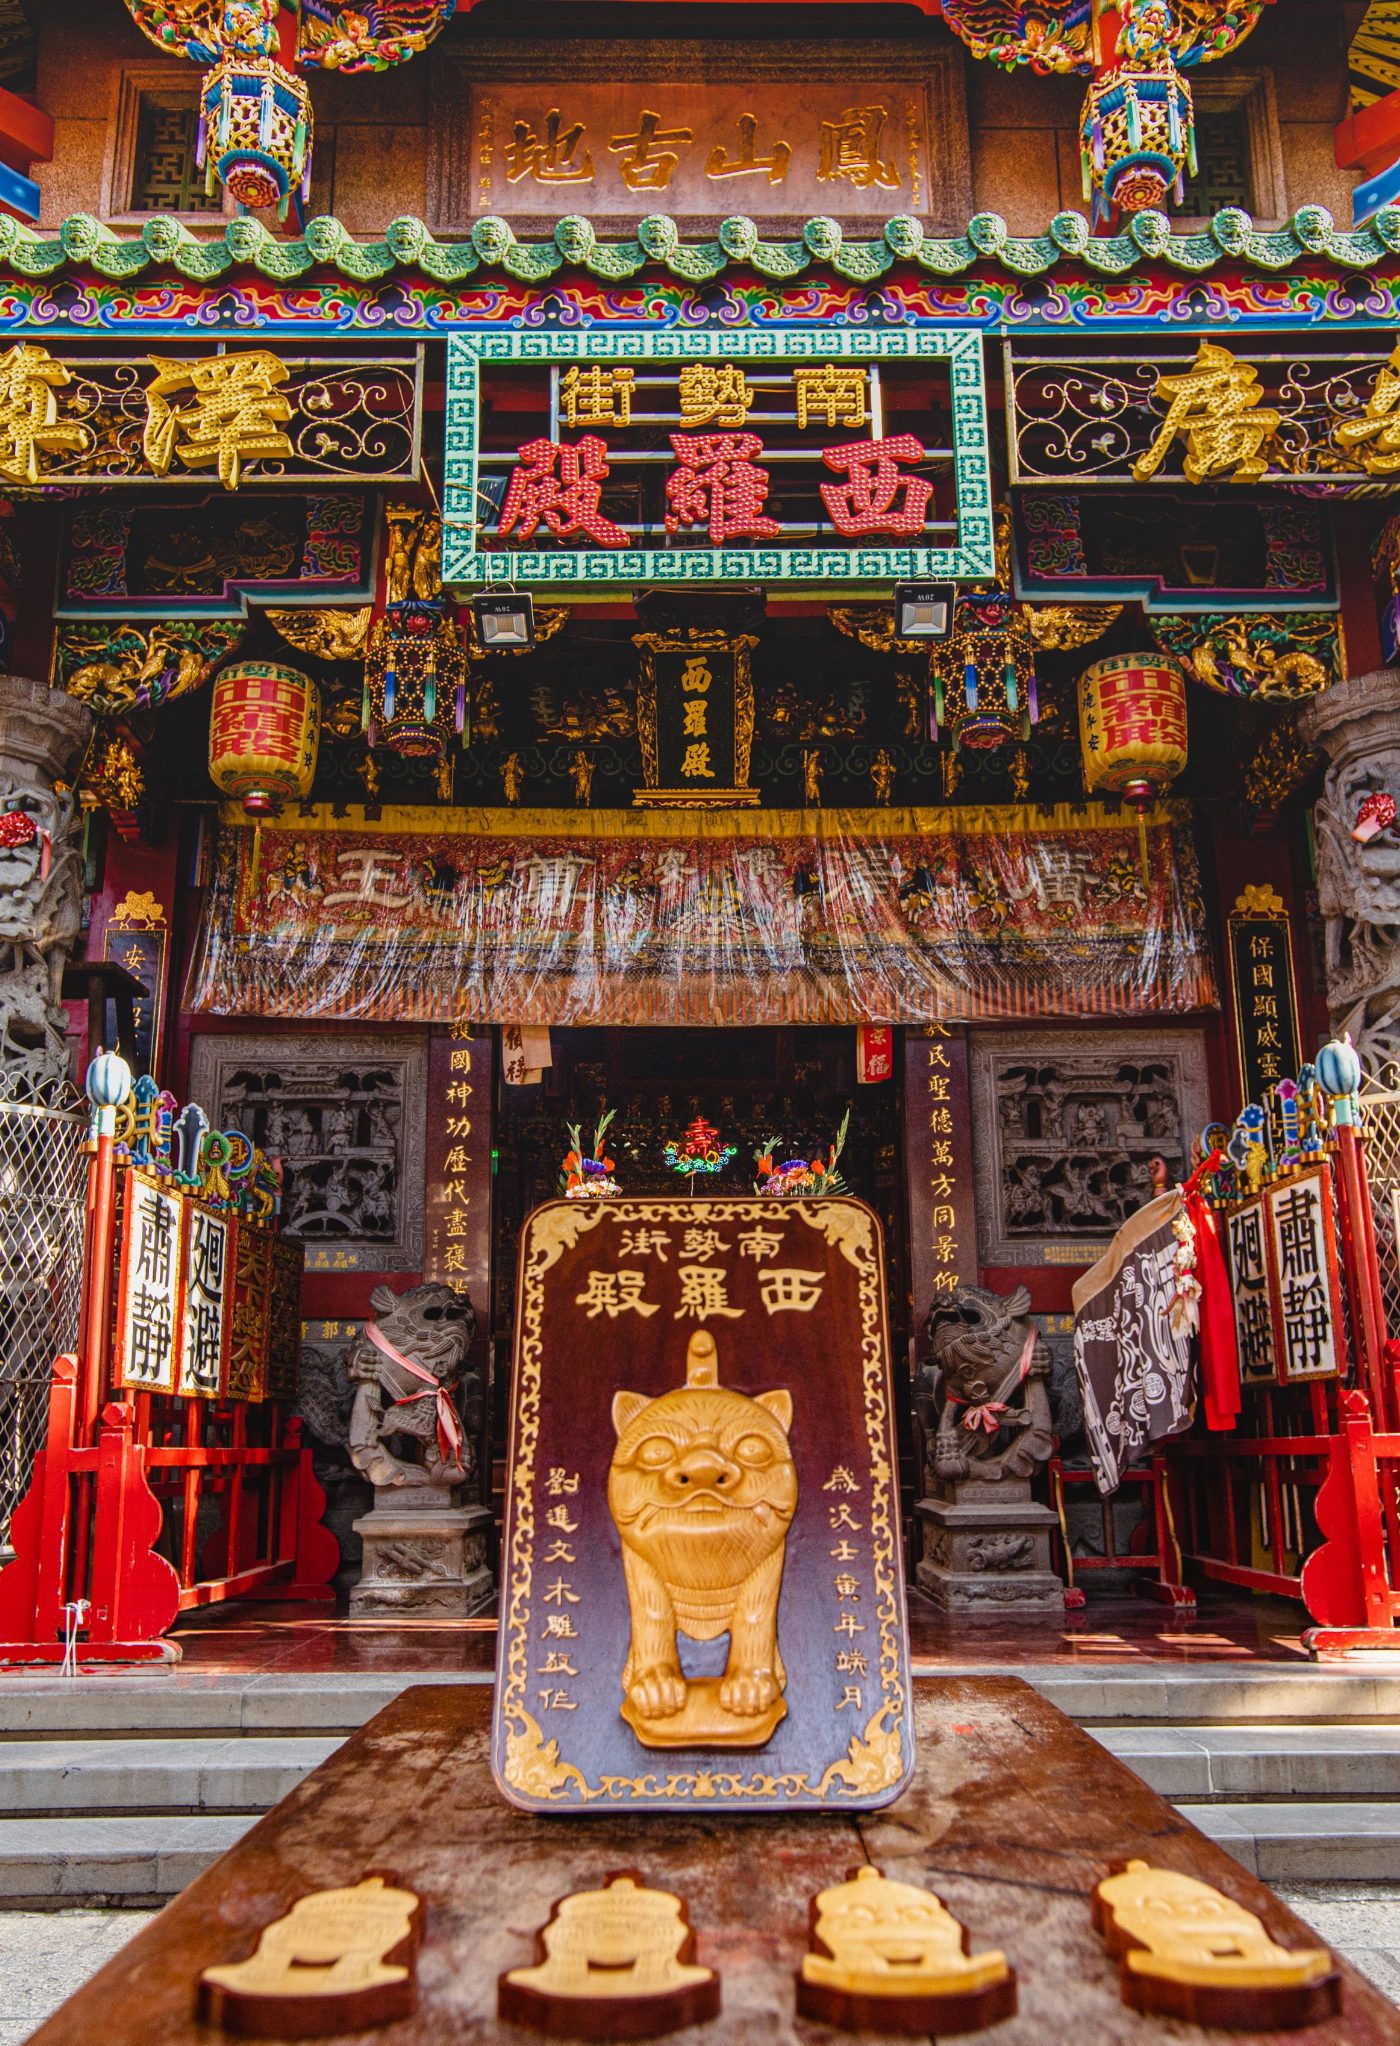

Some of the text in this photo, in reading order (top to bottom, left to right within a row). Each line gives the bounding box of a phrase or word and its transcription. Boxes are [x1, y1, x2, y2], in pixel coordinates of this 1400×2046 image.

[560, 363, 868, 429] 南勢街
[497, 433, 934, 548] 西羅殿
[211, 677, 306, 764] 西羅殿
[680, 656, 715, 778] 西羅殿
[684, 1117, 719, 1159] 壽
[618, 1225, 784, 1262] 南勢街
[576, 1264, 826, 1322] 西羅殿
